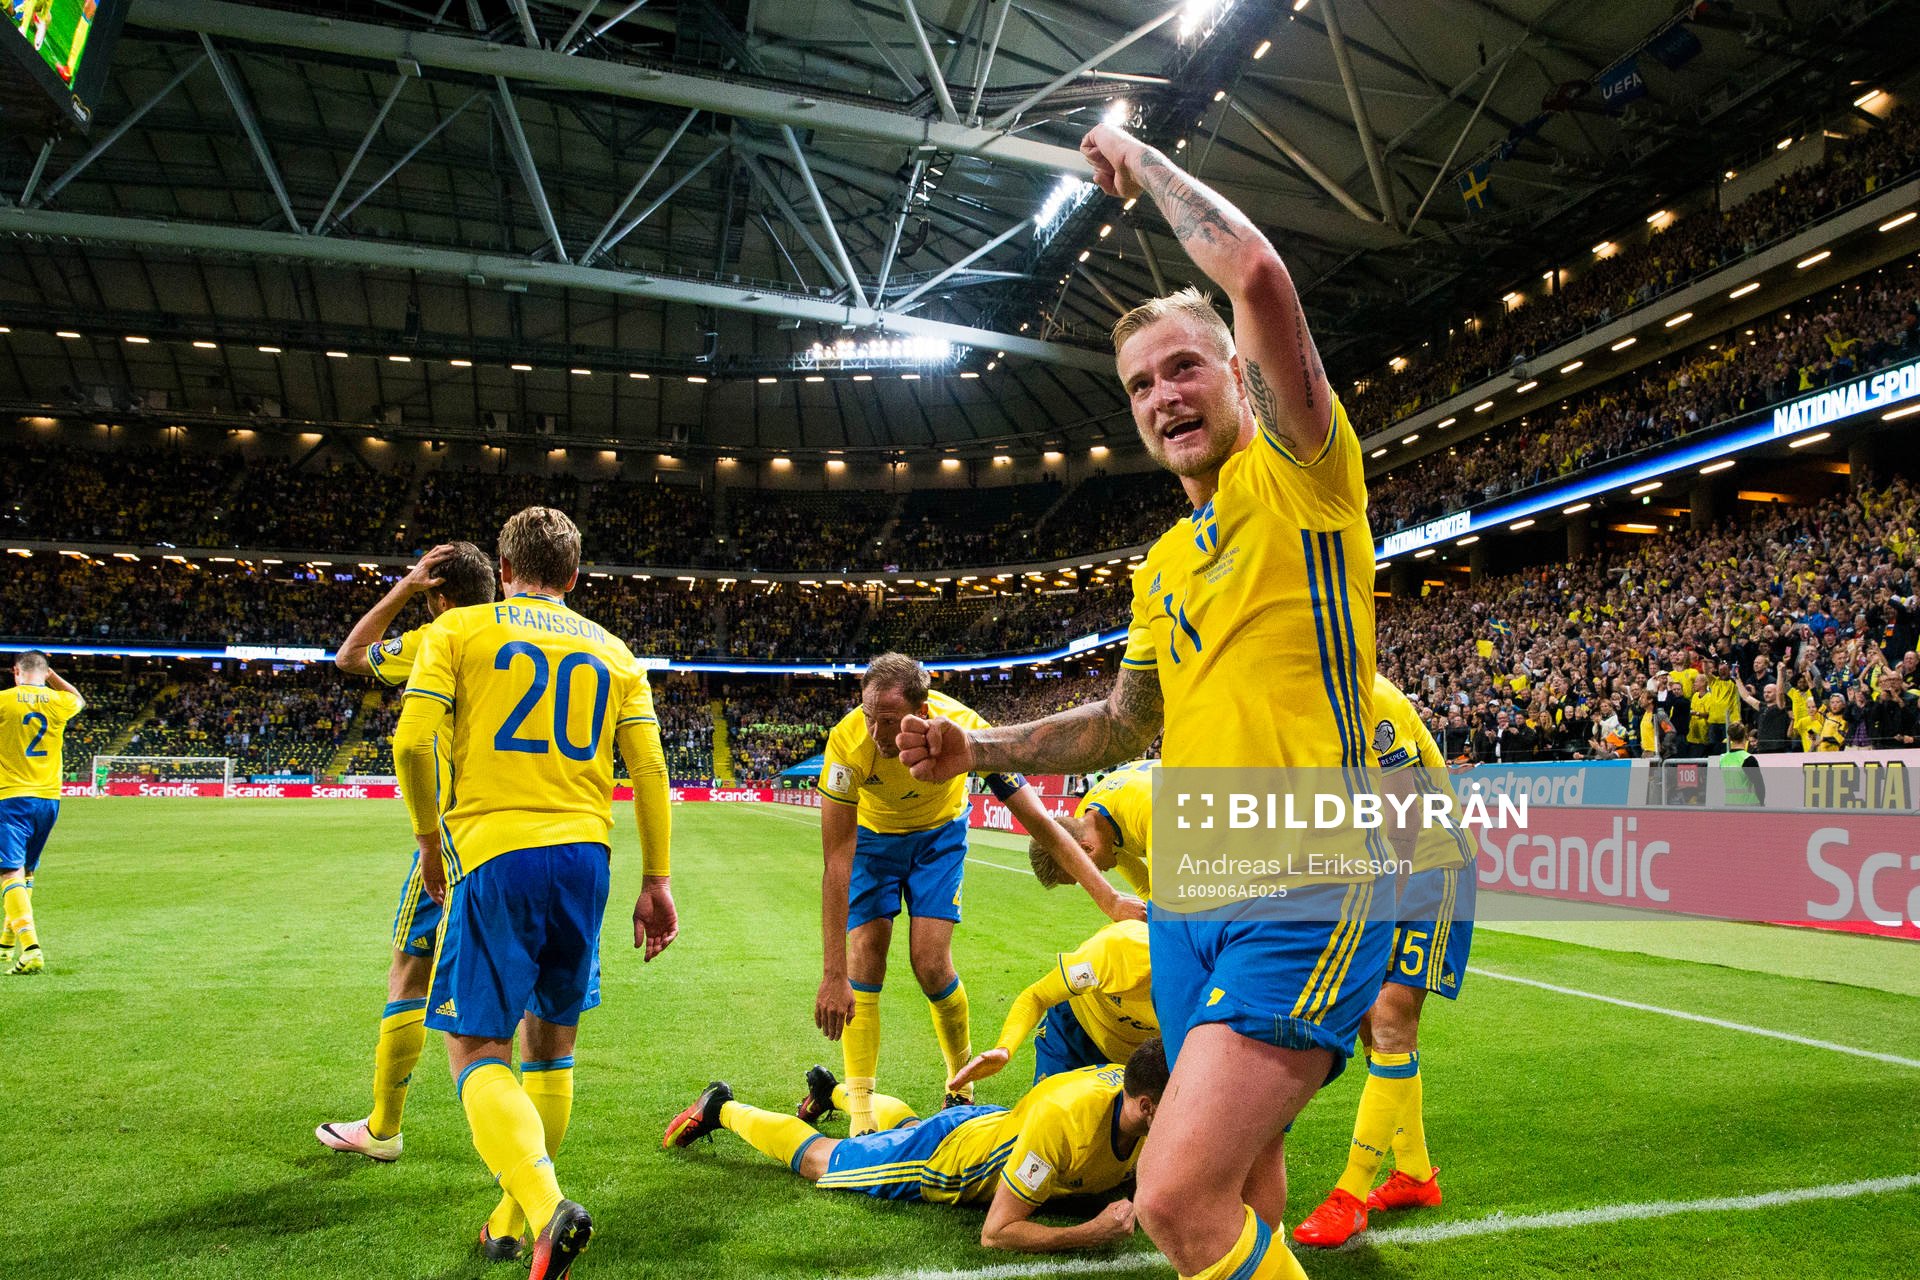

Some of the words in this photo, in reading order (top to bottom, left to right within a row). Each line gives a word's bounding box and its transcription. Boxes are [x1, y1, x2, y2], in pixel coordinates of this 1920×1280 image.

[1602, 72, 1643, 100] UEFA
[1774, 362, 1920, 435] NATIONALSPO
[494, 605, 606, 644] FRANSSON
[494, 641, 611, 762] 20
[23, 712, 48, 756] 2
[1380, 750, 1408, 767] RESPECT
[139, 783, 199, 797] Scandic
[227, 784, 285, 798] Scandic
[311, 785, 368, 798] Scandic
[1457, 767, 1586, 805] postnord
[1678, 769, 1696, 783] 108
[1803, 761, 1911, 809] HEJA
[709, 790, 761, 802] Scandic
[1479, 814, 1670, 902] Scandic
